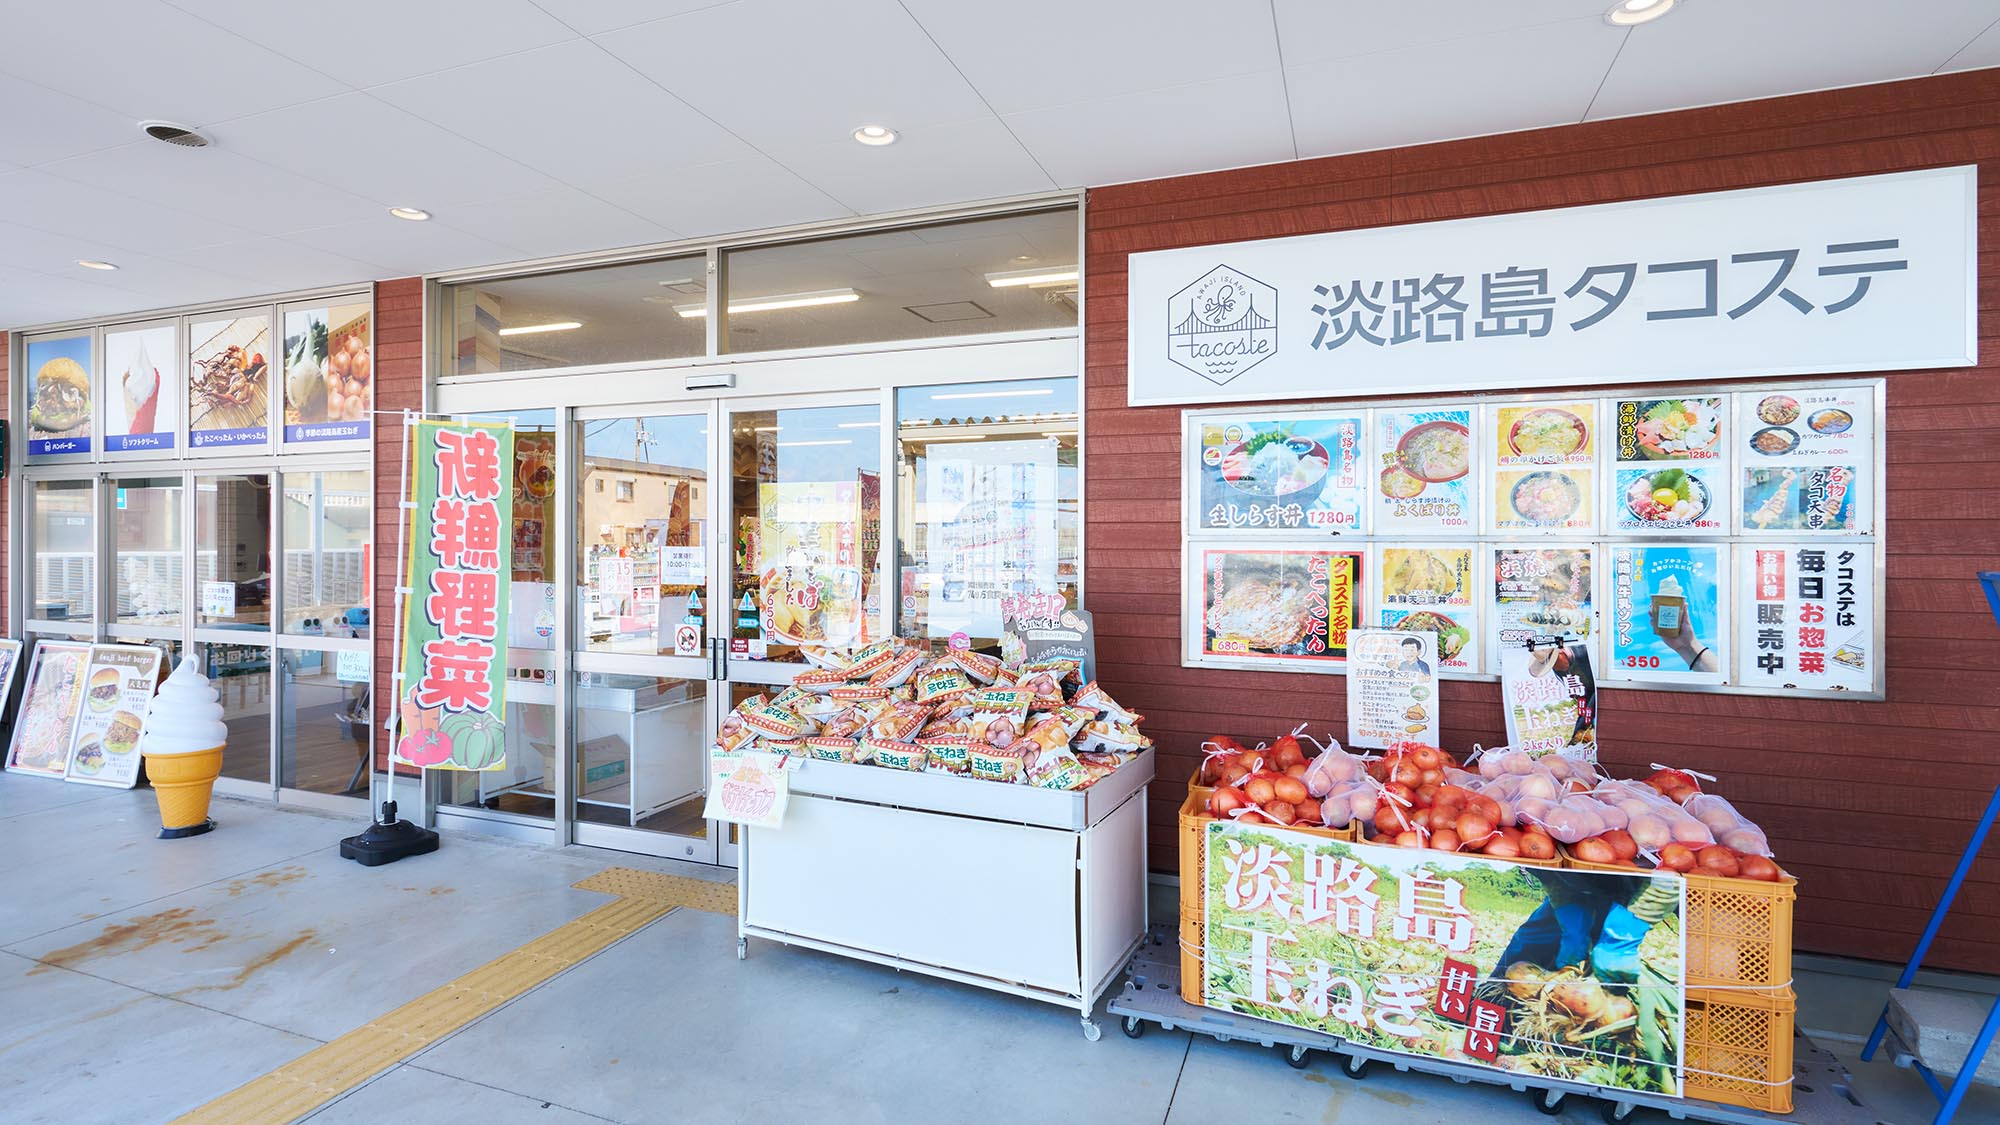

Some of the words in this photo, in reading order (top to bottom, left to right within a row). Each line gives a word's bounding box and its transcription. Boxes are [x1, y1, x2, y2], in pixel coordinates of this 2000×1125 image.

[1197, 278, 1217, 300] AWAJI
[1220, 276, 1247, 297] ISLAND
[1311, 239, 1908, 351] 淡路島タコステ
[1176, 336, 1270, 358] tacoste
[1827, 467, 1845, 496] 名物
[1394, 503, 1460, 517] よくばり丼
[1809, 472, 1825, 528] タコ天串
[1210, 504, 1303, 526] 生しらす丼
[1309, 511, 1355, 524] 1280円
[1695, 519, 1720, 528] 980円
[1333, 559, 1348, 645] タコステ名物
[1837, 550, 1855, 626] タコステは
[767, 595, 775, 640] 650円
[1305, 556, 1328, 652] たこぺったん
[1797, 549, 1825, 673] 毎日お惣菜
[1217, 641, 1247, 650] 680円
[1757, 604, 1784, 674] 販売中
[926, 678, 958, 695] 玉ねぎ
[983, 692, 1017, 702] 玉ねぎ
[816, 748, 842, 761] 玉ねぎ
[880, 751, 911, 768] 玉ねぎ
[933, 747, 967, 759] 玉ねぎ
[974, 757, 1003, 774] 玉ねぎ
[1221, 839, 1475, 952] 淡路島
[1221, 925, 1438, 1038] 玉ねぎ
[1440, 966, 1471, 1014] 甘い
[1469, 1006, 1499, 1054] 旨い
